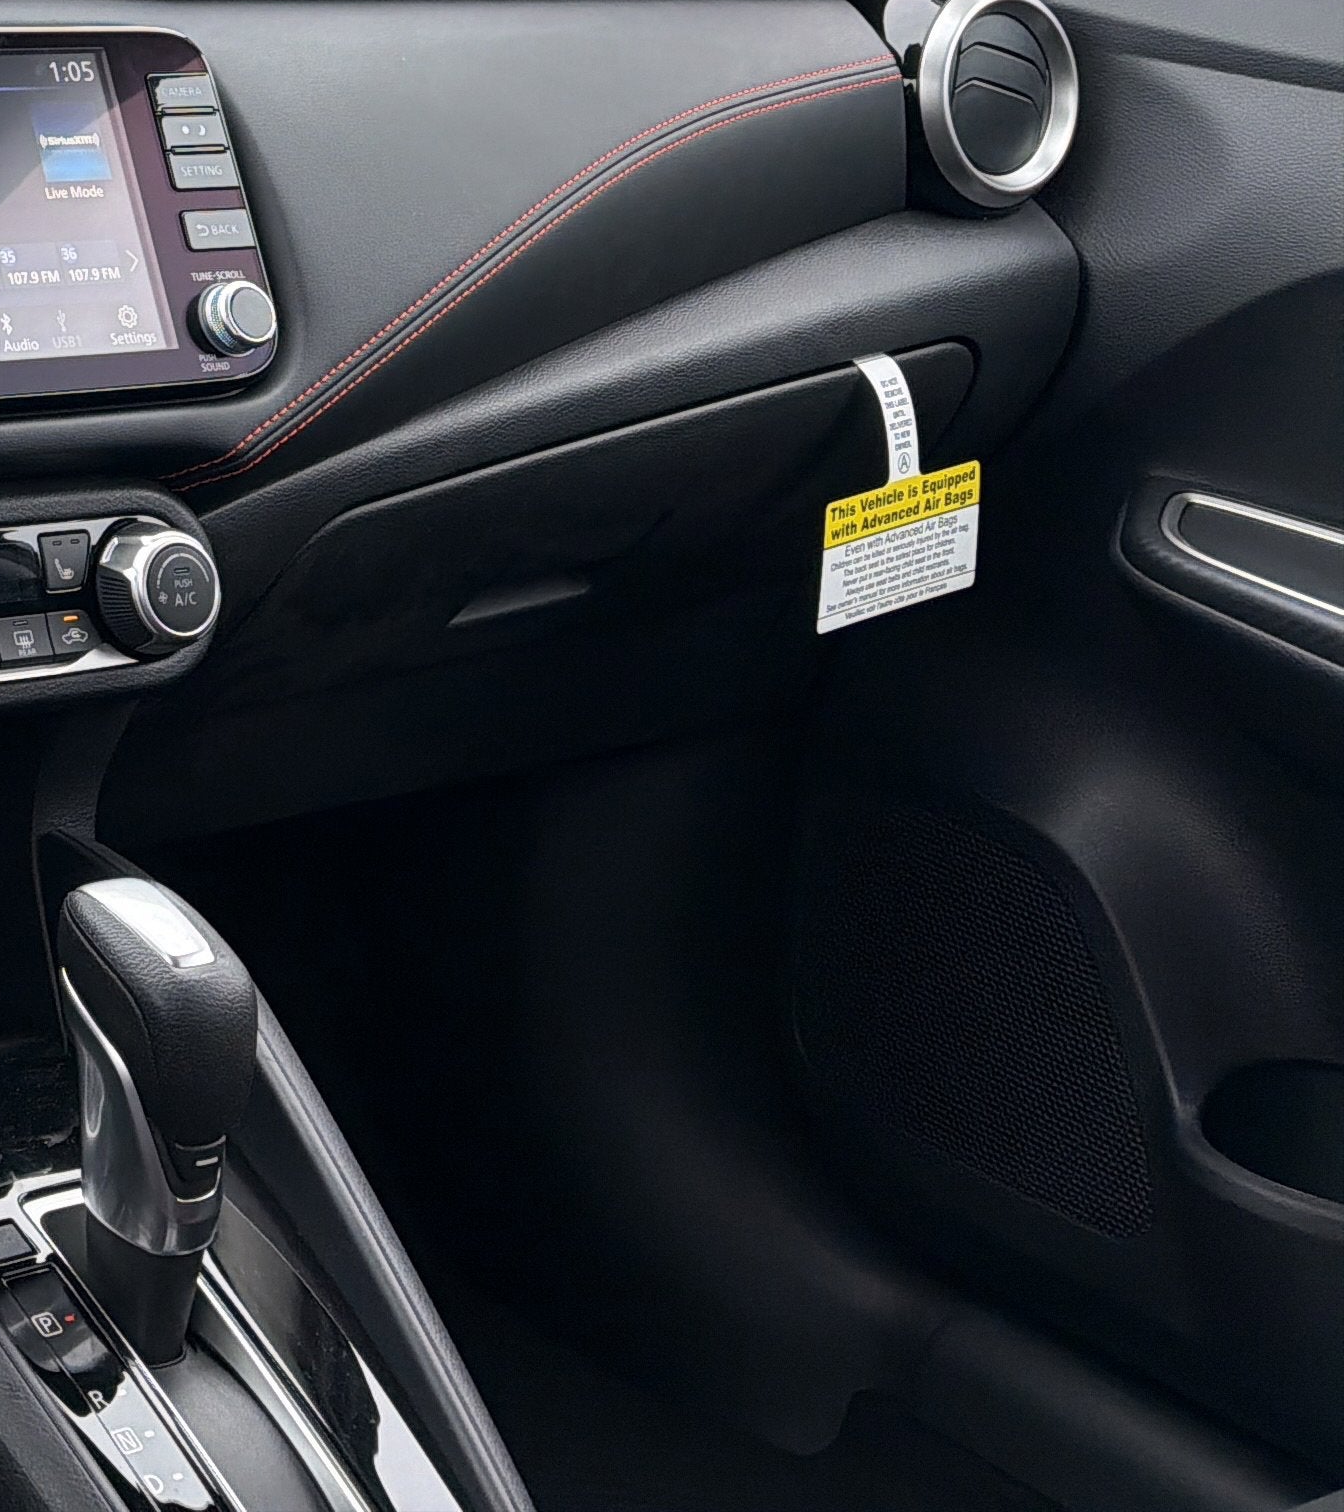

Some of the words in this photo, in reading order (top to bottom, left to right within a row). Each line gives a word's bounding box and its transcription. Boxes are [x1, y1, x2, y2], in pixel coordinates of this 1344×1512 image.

[49, 61, 95, 82] 1:05
[180, 165, 223, 177] SETTING
[44, 188, 69, 200] Live
[71, 185, 104, 199] Mode
[211, 224, 240, 236] BACK
[0, 249, 16, 264] 35
[61, 247, 77, 261] 36
[7, 271, 40, 285] 107.9
[40, 269, 61, 283] FM
[68, 268, 100, 282] 107.9
[101, 267, 121, 280] FM
[4, 339, 40, 353] Audio
[110, 331, 157, 346] Settings
[201, 362, 230, 372] SOUND
[830, 504, 855, 521] This
[860, 489, 904, 512] Vehicle
[908, 485, 918, 497] is
[922, 466, 976, 494] Equipped
[831, 523, 857, 540] with
[862, 501, 920, 531] Advanced
[924, 497, 941, 513] Air
[944, 489, 973, 506] Bags
[845, 544, 865, 557] Even
[867, 537, 883, 548] with
[885, 522, 923, 545] Advanced
[925, 521, 936, 532] Air
[938, 515, 958, 528] Bags
[174, 578, 193, 587] PUSH
[175, 592, 198, 607] A/C
[87, 1390, 110, 1410] R
